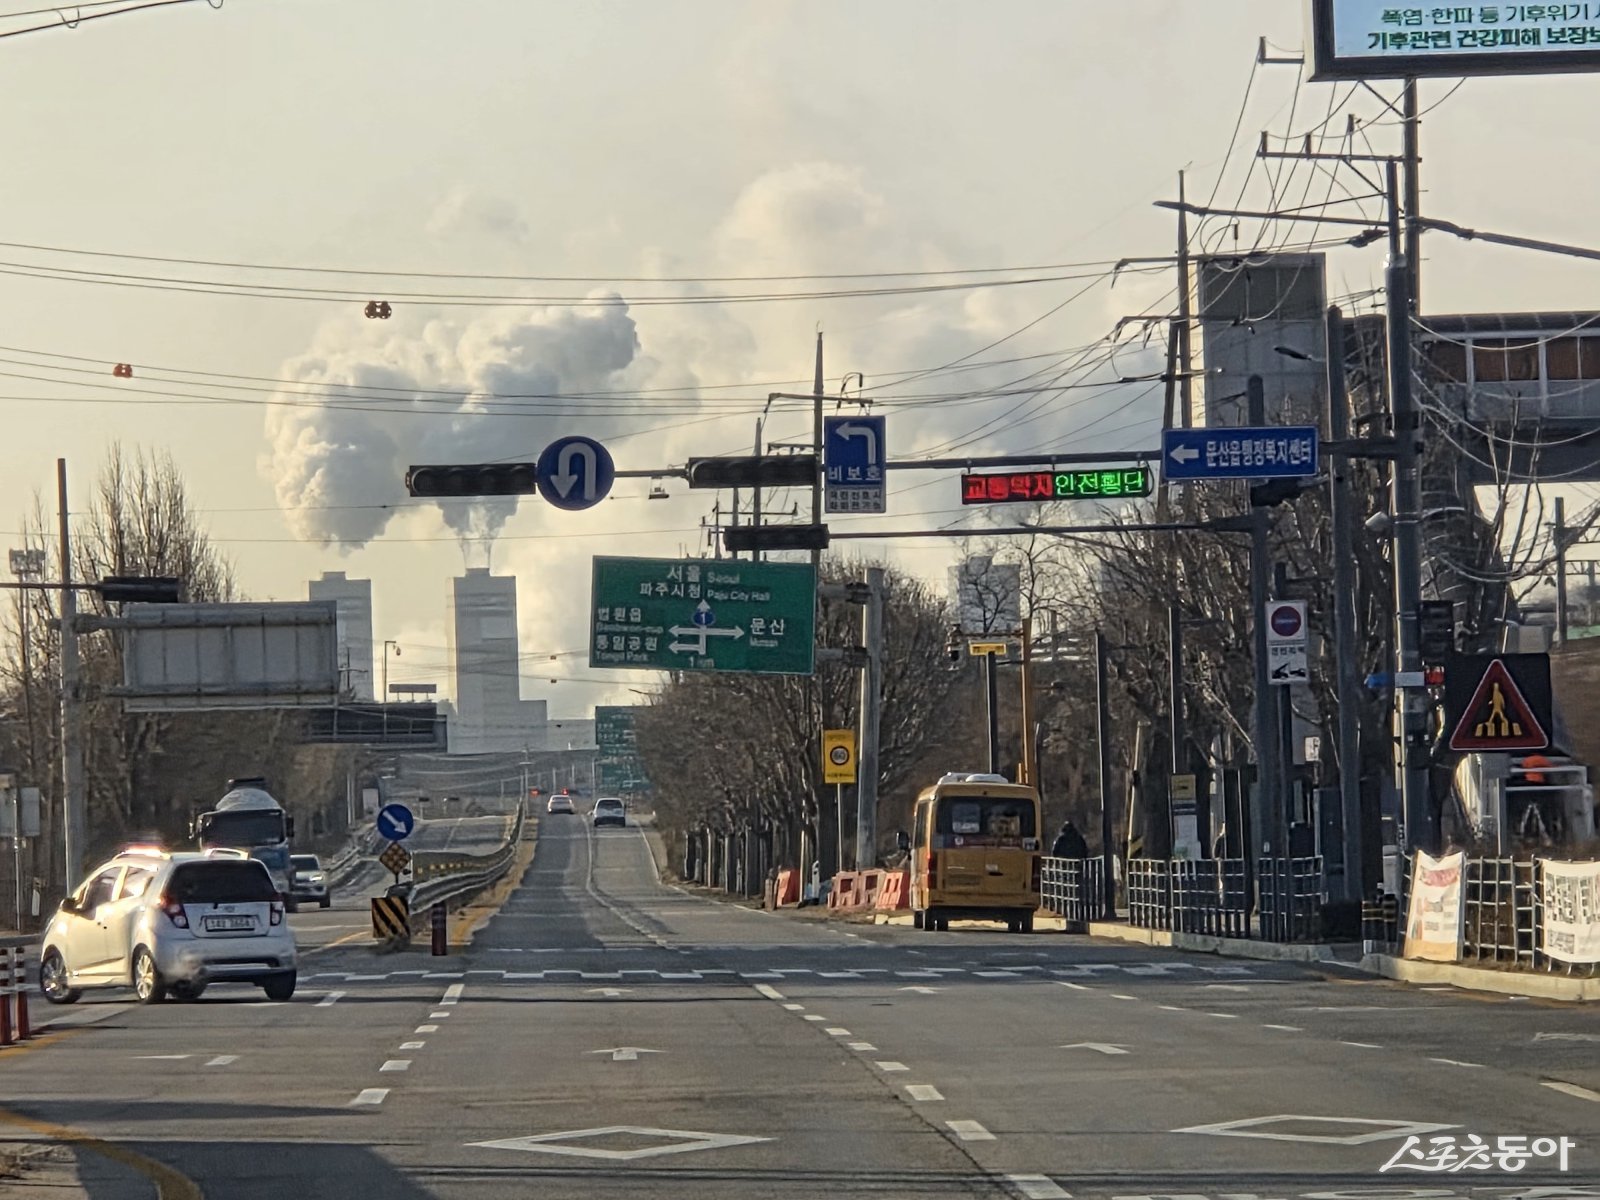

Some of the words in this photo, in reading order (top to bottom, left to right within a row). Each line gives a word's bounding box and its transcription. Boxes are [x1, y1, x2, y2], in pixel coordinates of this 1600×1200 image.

[1381, 7, 1473, 26] 폭염·한파
[1479, 8, 1498, 24] 등
[1506, 4, 1588, 22] 기후위기
[1368, 30, 1451, 49] 기후관련
[1457, 28, 1541, 48] 건강피해
[1206, 438, 1312, 467] 문산읍행정복지센터
[828, 465, 882, 482] 비보호
[667, 565, 701, 583] 서울
[707, 572, 741, 584] Seoul
[639, 583, 701, 599] 파주시청
[730, 590, 749, 602] City
[751, 591, 771, 601] Hall
[700, 614, 706, 624] 1
[750, 617, 785, 636] 문산
[596, 634, 658, 651] 통일공원
